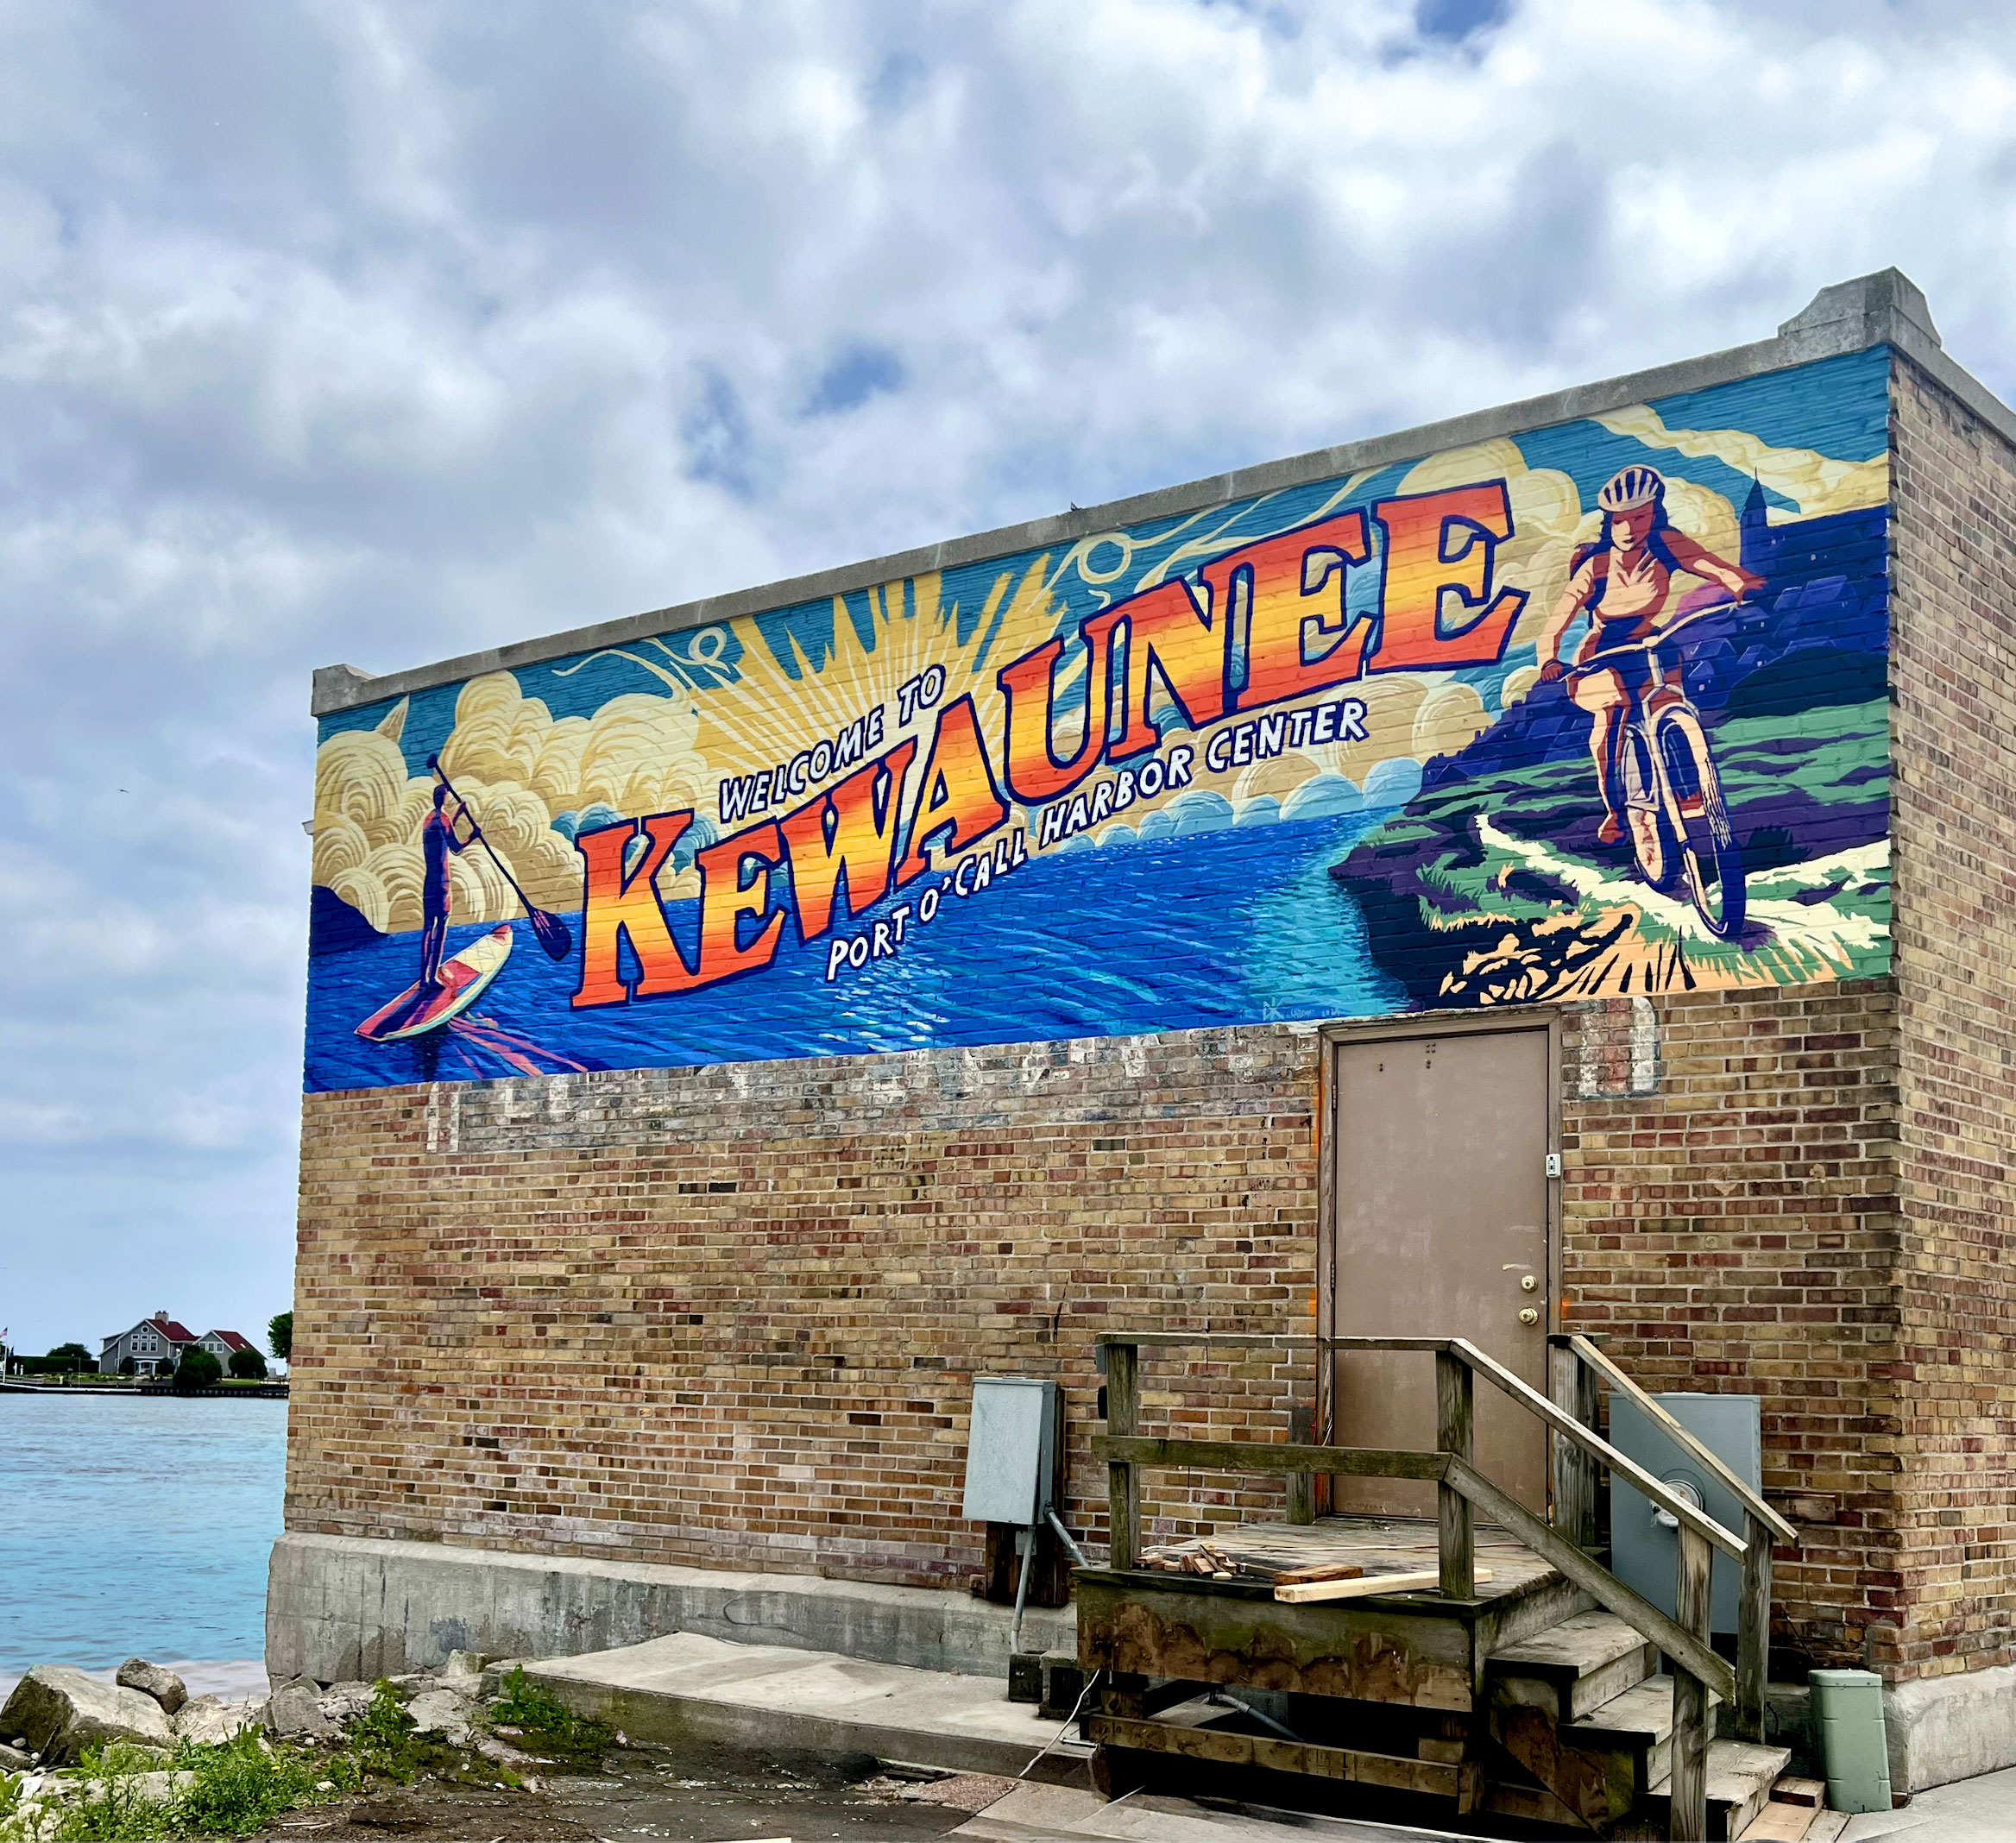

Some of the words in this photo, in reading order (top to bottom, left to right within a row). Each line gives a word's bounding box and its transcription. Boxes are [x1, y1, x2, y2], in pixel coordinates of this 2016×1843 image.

[570, 479, 1531, 1011] KEWAUNEE
[719, 703, 885, 824] WELCOME
[897, 664, 947, 728] TO
[826, 903, 913, 983] PORT
[917, 827, 1028, 927] O'CALL
[1039, 745, 1195, 850] HARBOR
[1206, 697, 1370, 773] CENTER
